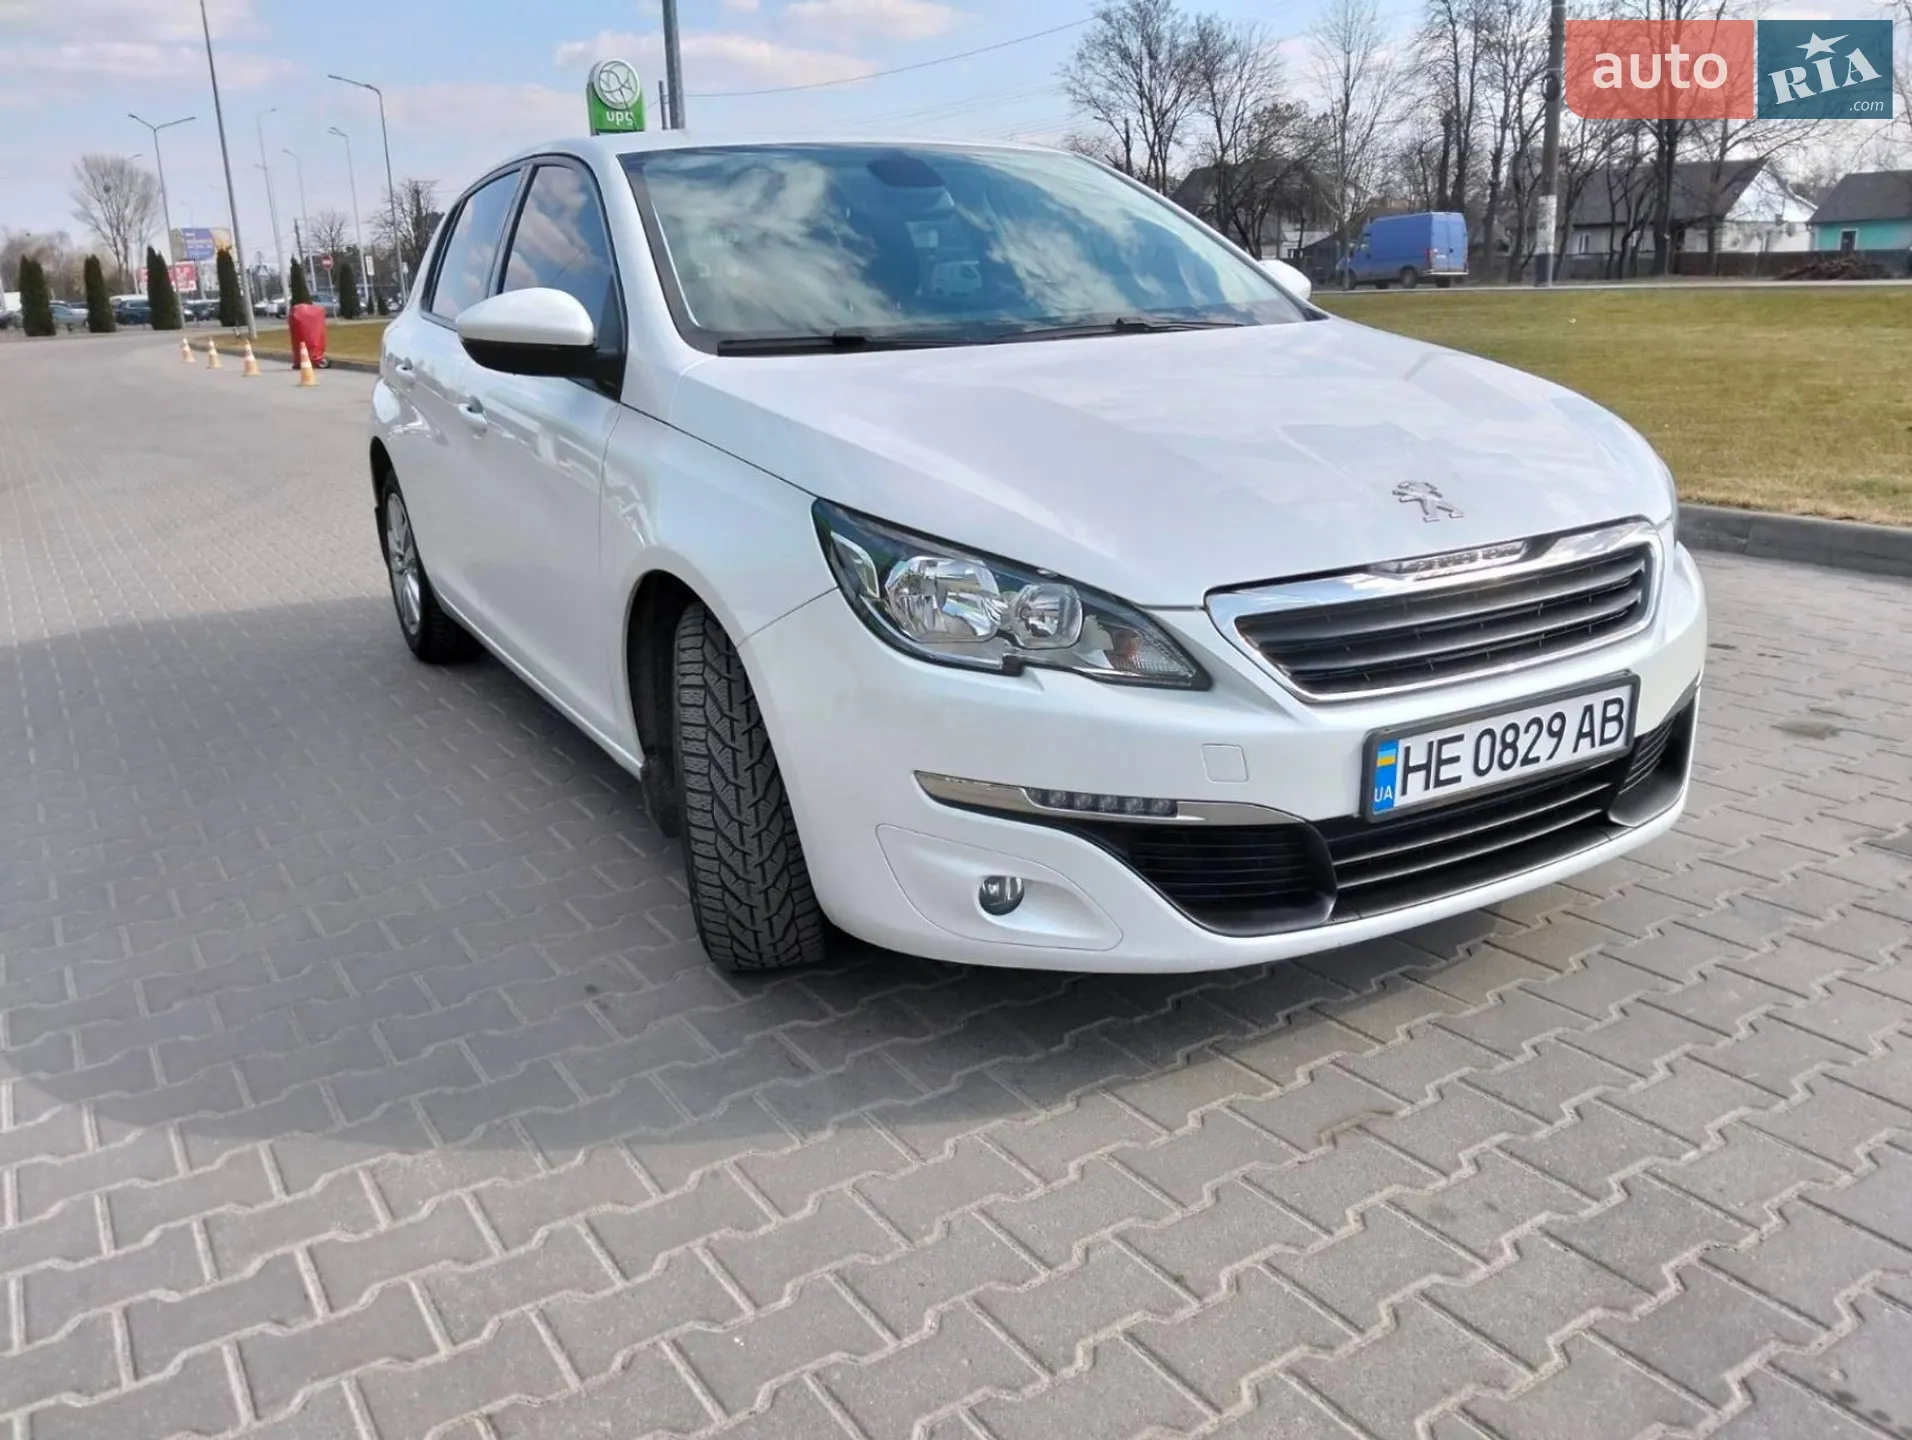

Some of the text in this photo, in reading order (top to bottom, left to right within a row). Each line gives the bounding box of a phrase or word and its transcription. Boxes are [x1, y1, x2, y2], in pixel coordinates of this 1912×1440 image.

[1400, 697, 1625, 796] HE 0829 AB
[1373, 783, 1393, 803] UA
